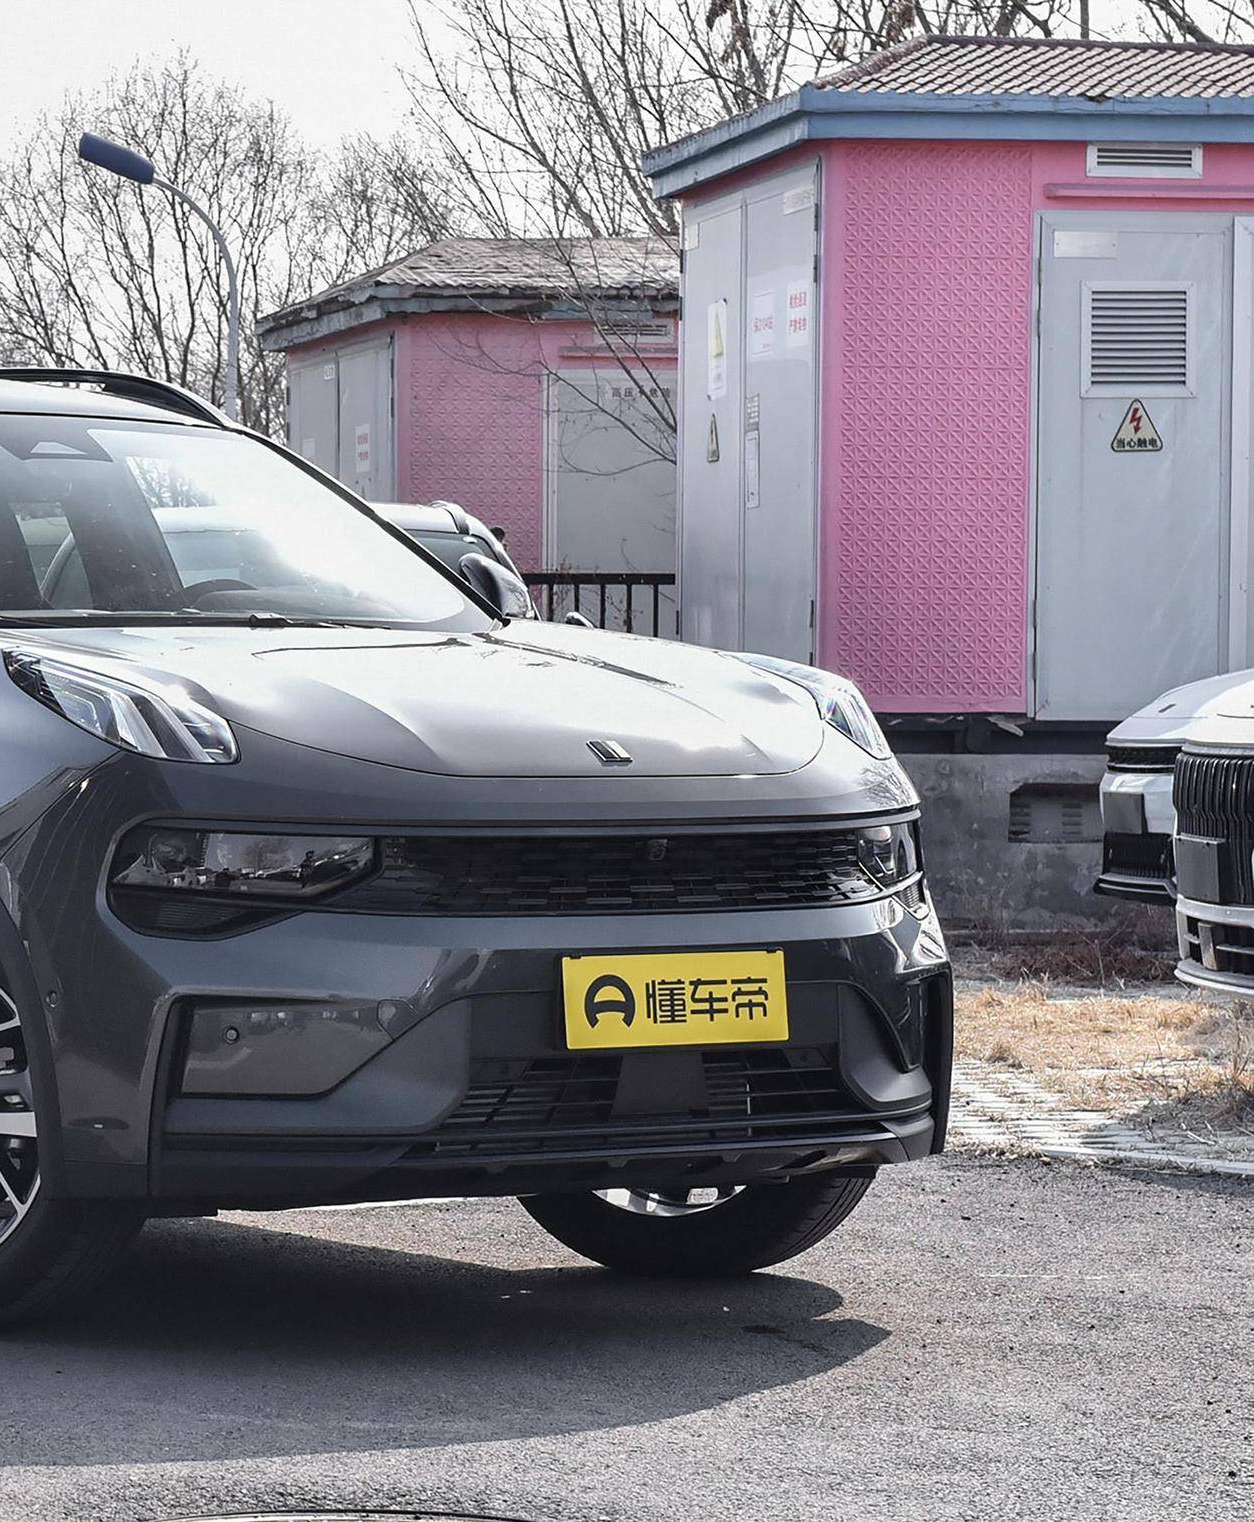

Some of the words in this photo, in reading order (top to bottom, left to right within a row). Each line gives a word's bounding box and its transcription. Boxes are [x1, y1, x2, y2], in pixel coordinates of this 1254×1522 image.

[1116, 437, 1159, 449] 当心触电
[645, 976, 770, 1025] 懂车帝
